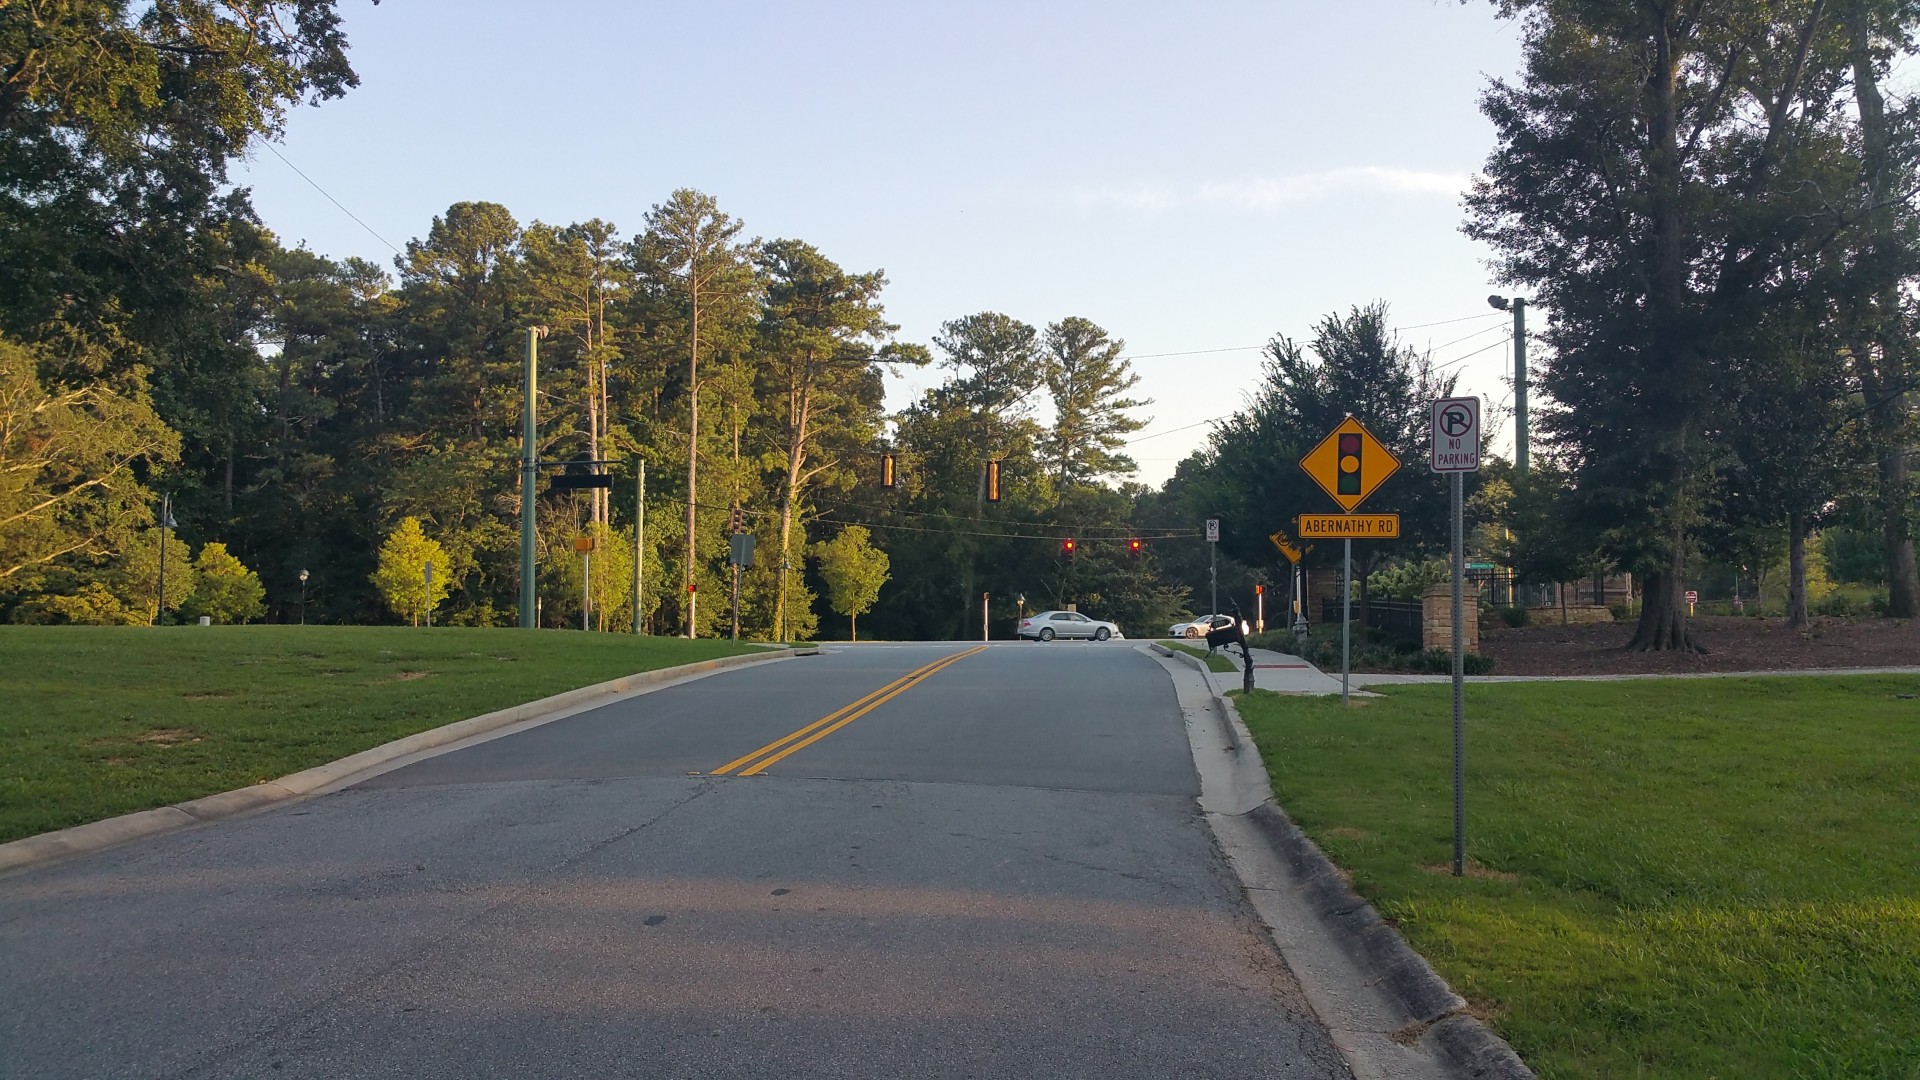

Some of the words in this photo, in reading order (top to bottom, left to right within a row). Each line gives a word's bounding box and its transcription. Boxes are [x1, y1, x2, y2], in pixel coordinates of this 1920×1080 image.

[1449, 438, 1461, 450] NO
[1438, 453, 1475, 465] PARKING
[1305, 519, 1373, 533] ABERNATHY
[1378, 519, 1393, 533] RD
